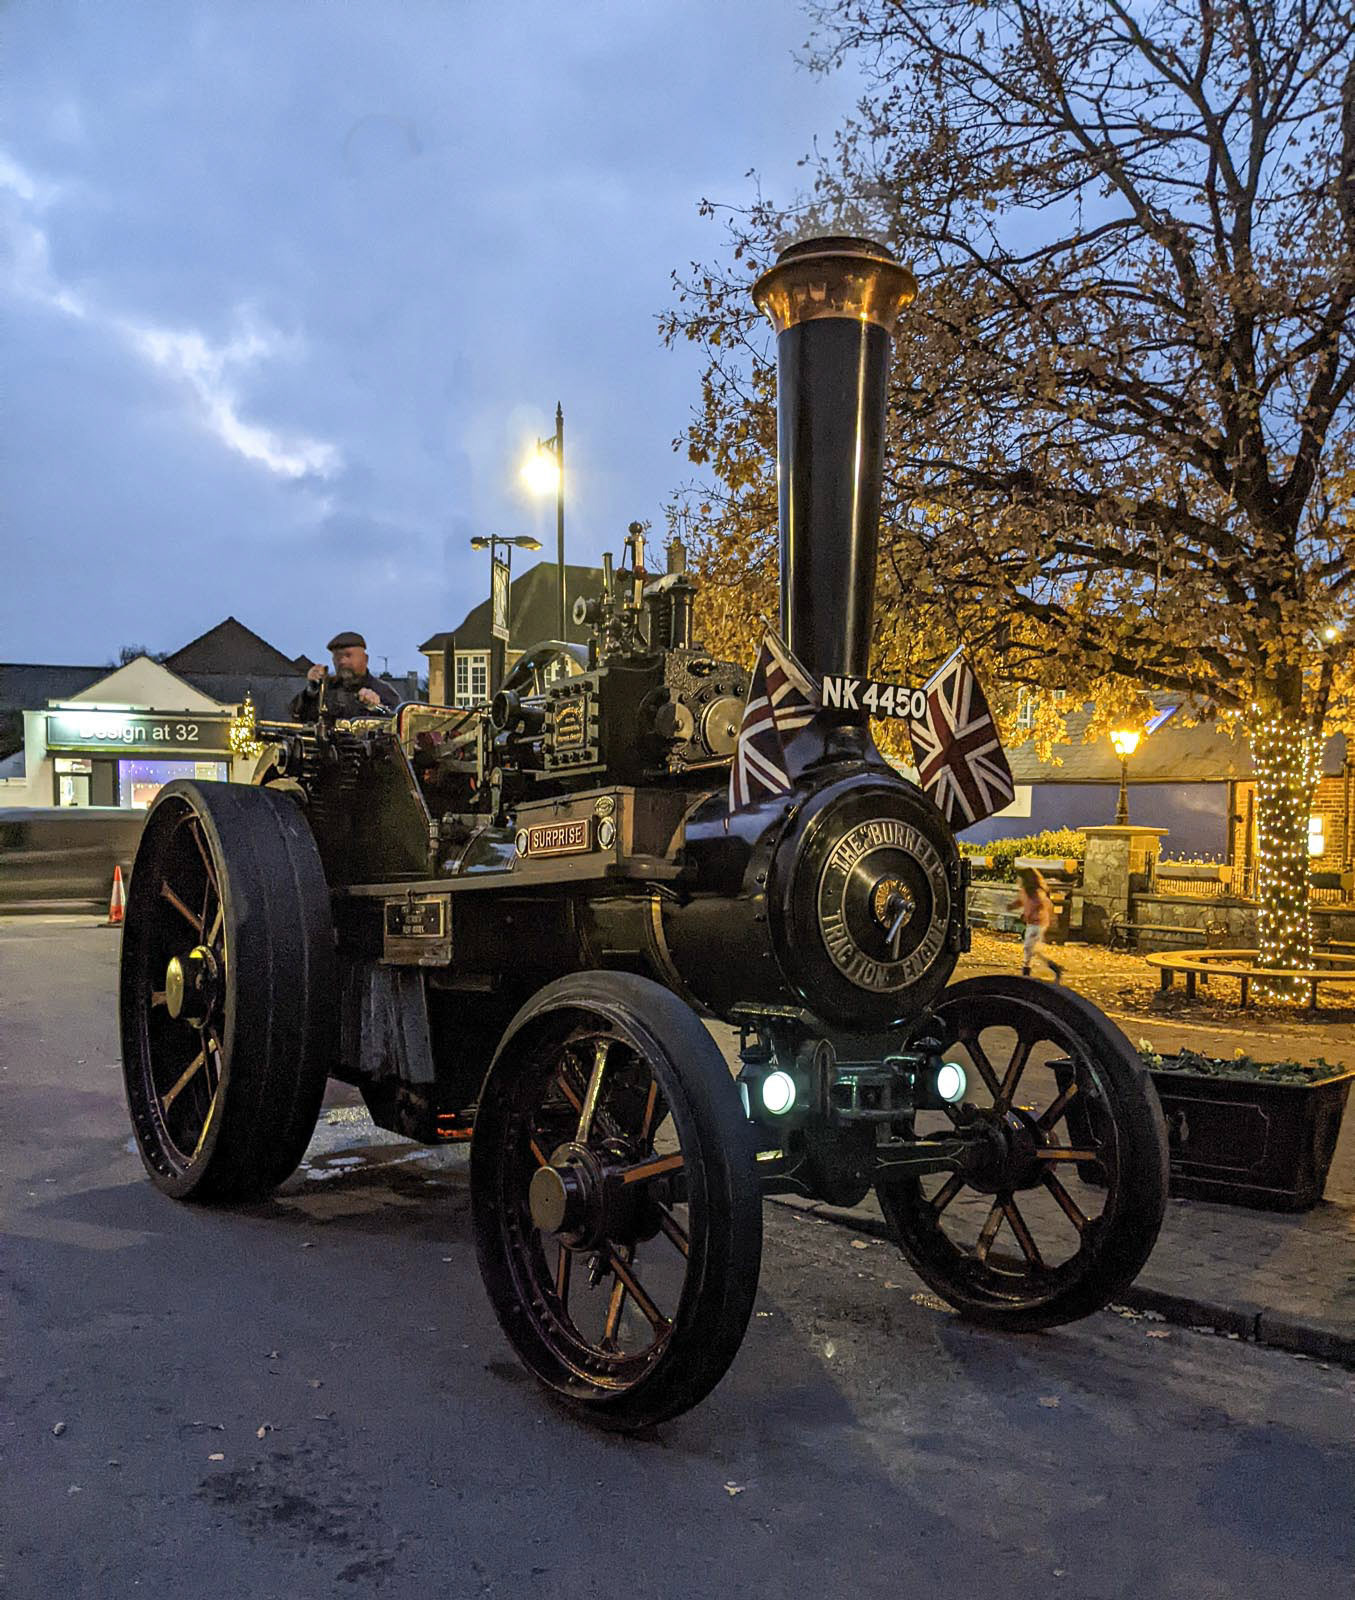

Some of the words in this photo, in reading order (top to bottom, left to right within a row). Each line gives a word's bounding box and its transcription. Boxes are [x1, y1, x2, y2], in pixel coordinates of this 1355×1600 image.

[822, 675, 860, 711] NK
[862, 683, 926, 719] 4450
[152, 725, 171, 740] at
[175, 724, 199, 741] 32
[533, 826, 582, 848] SURPRISE
[831, 833, 863, 876] THE
[822, 909, 888, 987] TRACTION
[902, 914, 947, 983] ENGINE
